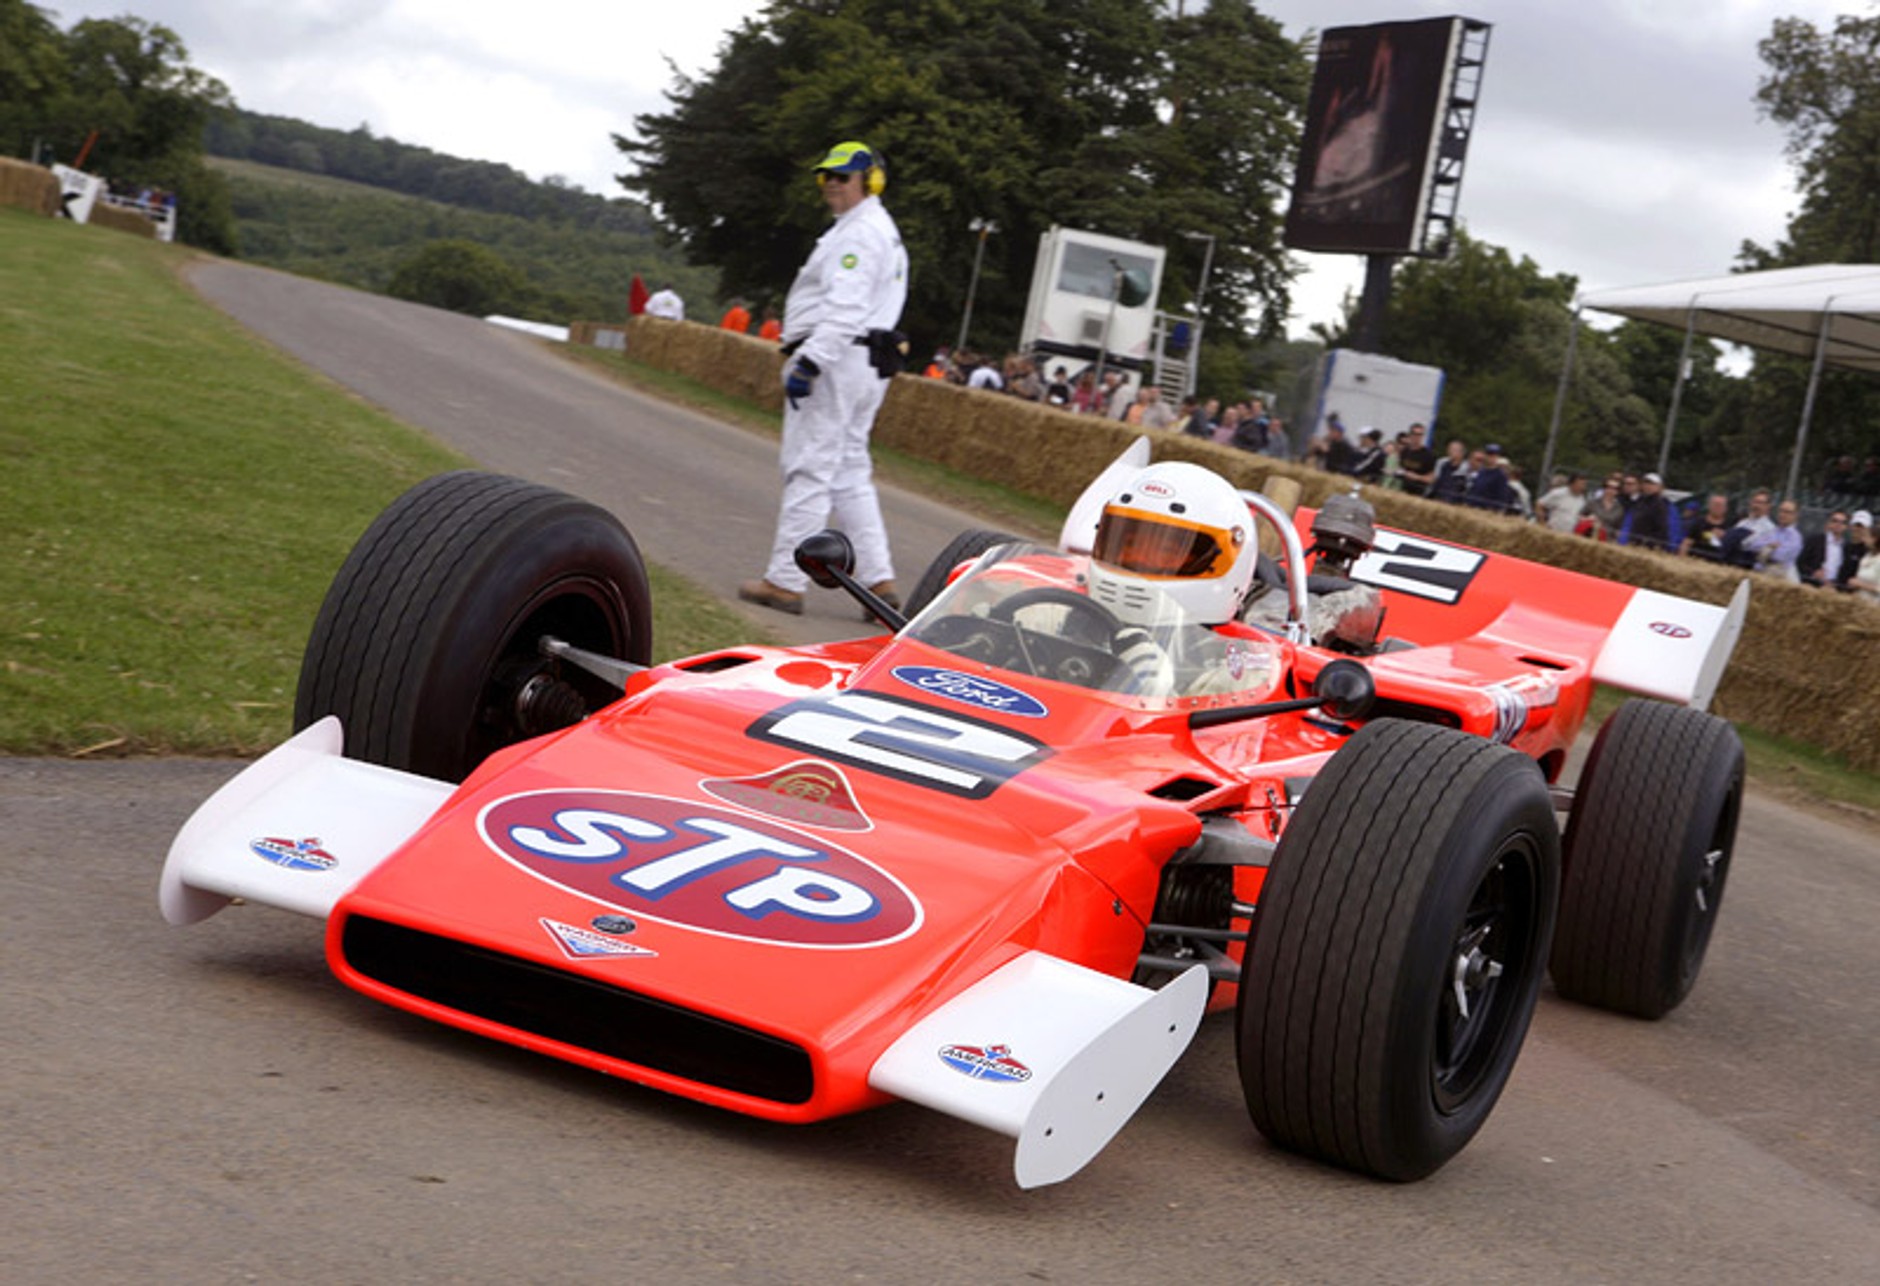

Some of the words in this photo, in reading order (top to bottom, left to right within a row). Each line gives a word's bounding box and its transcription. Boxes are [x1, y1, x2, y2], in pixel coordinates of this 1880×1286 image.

[1349, 528, 1484, 604] 2
[917, 672, 1020, 707] Ford
[762, 693, 1044, 793] 2
[509, 809, 883, 924] STP
[942, 1048, 1030, 1079] AMERICAN
